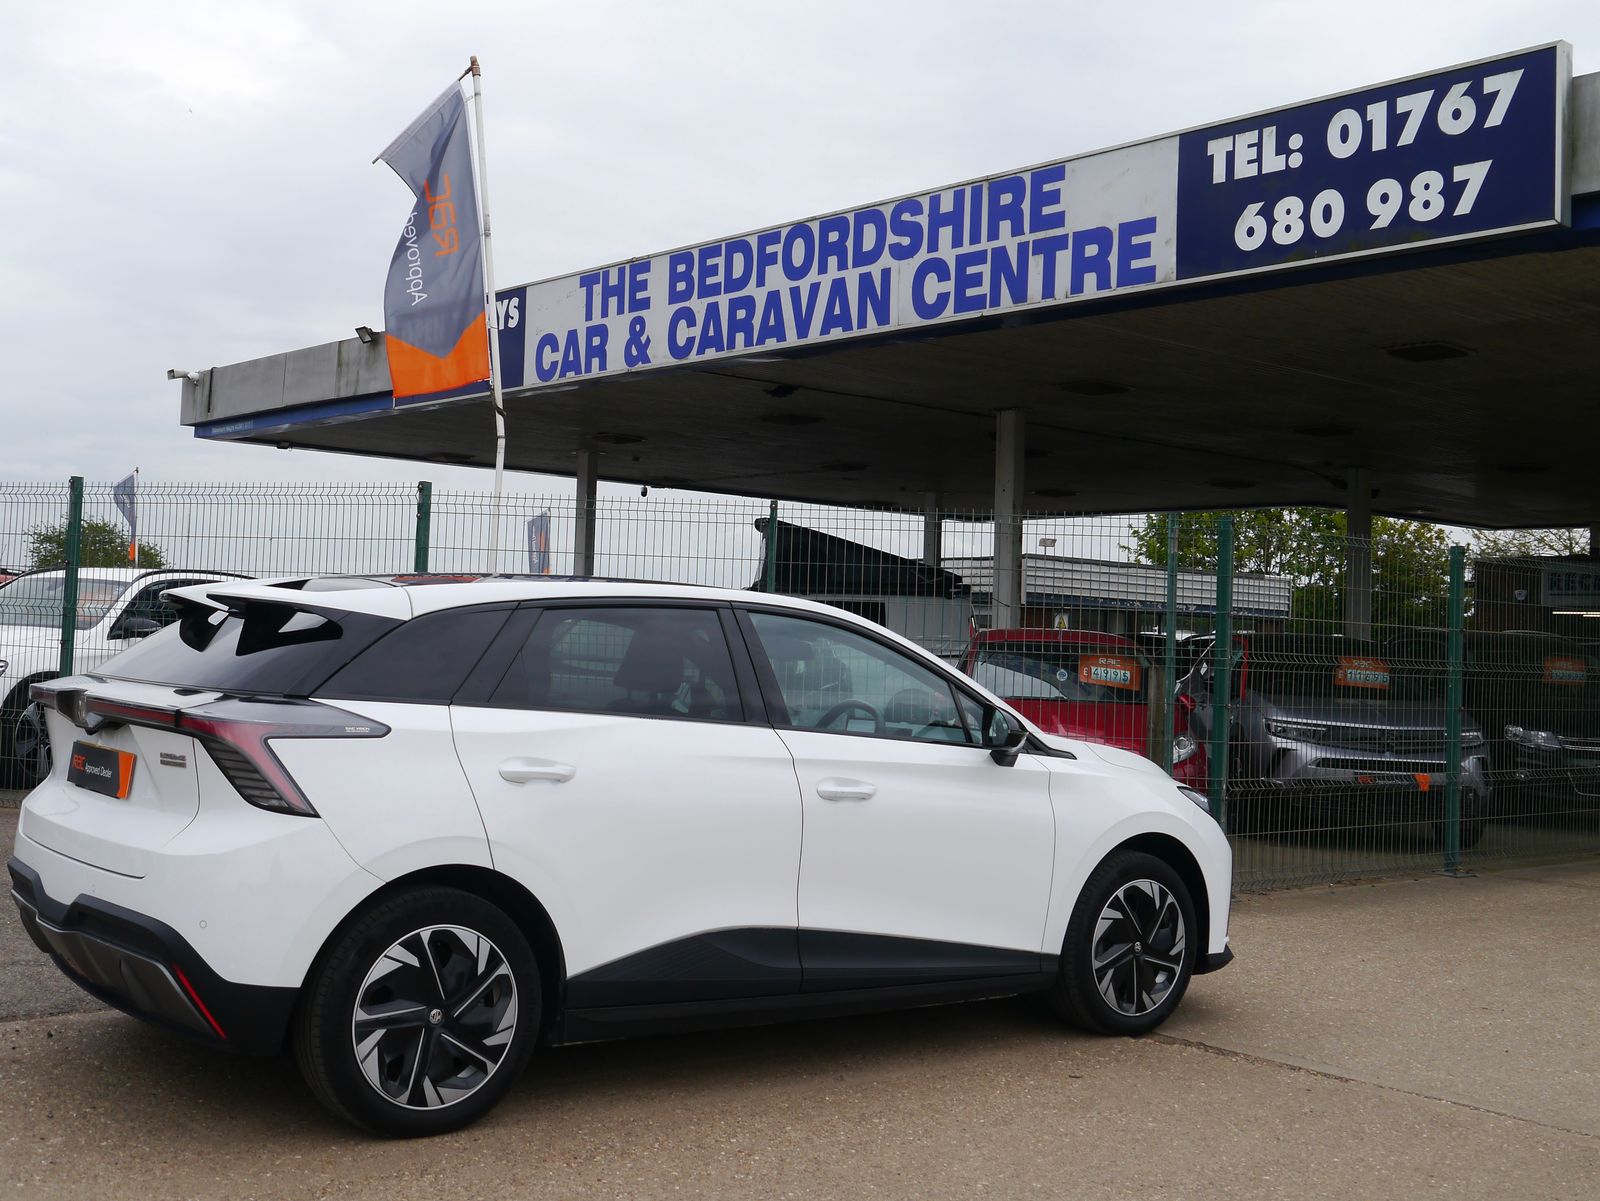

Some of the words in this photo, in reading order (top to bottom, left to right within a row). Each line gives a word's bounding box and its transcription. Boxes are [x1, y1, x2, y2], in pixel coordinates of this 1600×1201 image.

[1207, 125, 1303, 184] TEL:
[1326, 68, 1525, 159] 01767
[579, 260, 651, 322] THE
[668, 164, 1066, 305] BEDFORDSHIRE
[1234, 188, 1345, 251] 680
[1366, 159, 1493, 230] 987
[495, 296, 520, 331] YS
[535, 323, 609, 383] CAR
[624, 315, 651, 368] &
[667, 267, 892, 360] CARAVAN
[911, 216, 1157, 321] CENTRE
